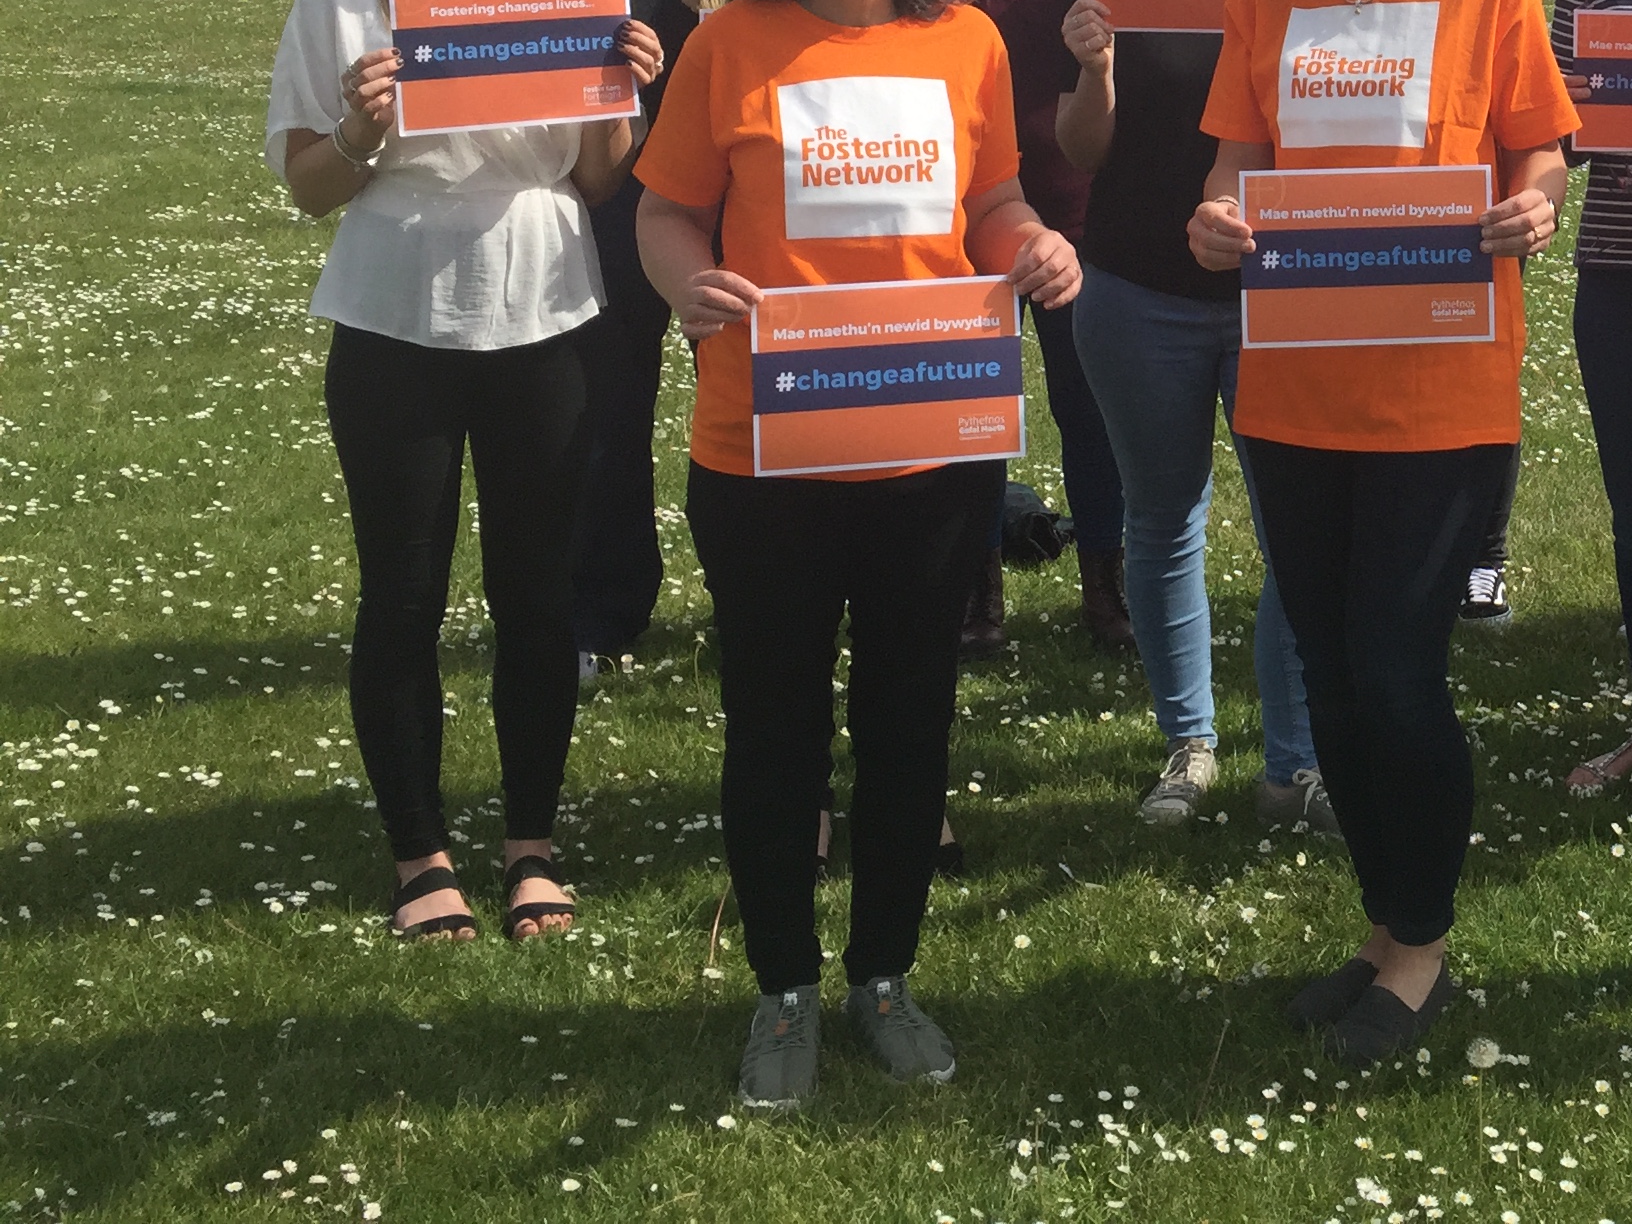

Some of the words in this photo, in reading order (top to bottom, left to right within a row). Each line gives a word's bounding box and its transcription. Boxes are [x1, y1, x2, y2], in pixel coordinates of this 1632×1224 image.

[430, 3, 495, 18] Fostering
[497, 0, 554, 14] changes
[414, 35, 615, 63] #changeafuture
[1310, 48, 1338, 60] The
[1589, 41, 1613, 50] Mae
[1292, 53, 1415, 80] Fostering
[1291, 75, 1405, 99] Network
[815, 126, 847, 140] The
[801, 133, 940, 163] Fostering
[802, 159, 933, 188] Network
[1260, 208, 1289, 220] Mae
[1292, 206, 1359, 219] maethu'n
[1362, 204, 1405, 217] newid
[1408, 203, 1473, 218] bywydau
[1261, 245, 1472, 271] #changeafuture
[773, 328, 805, 341] Mae
[808, 322, 881, 338] maethu'n
[884, 319, 930, 333] newid
[933, 315, 1001, 332] bywydau
[775, 361, 1001, 393] #changeafuture
